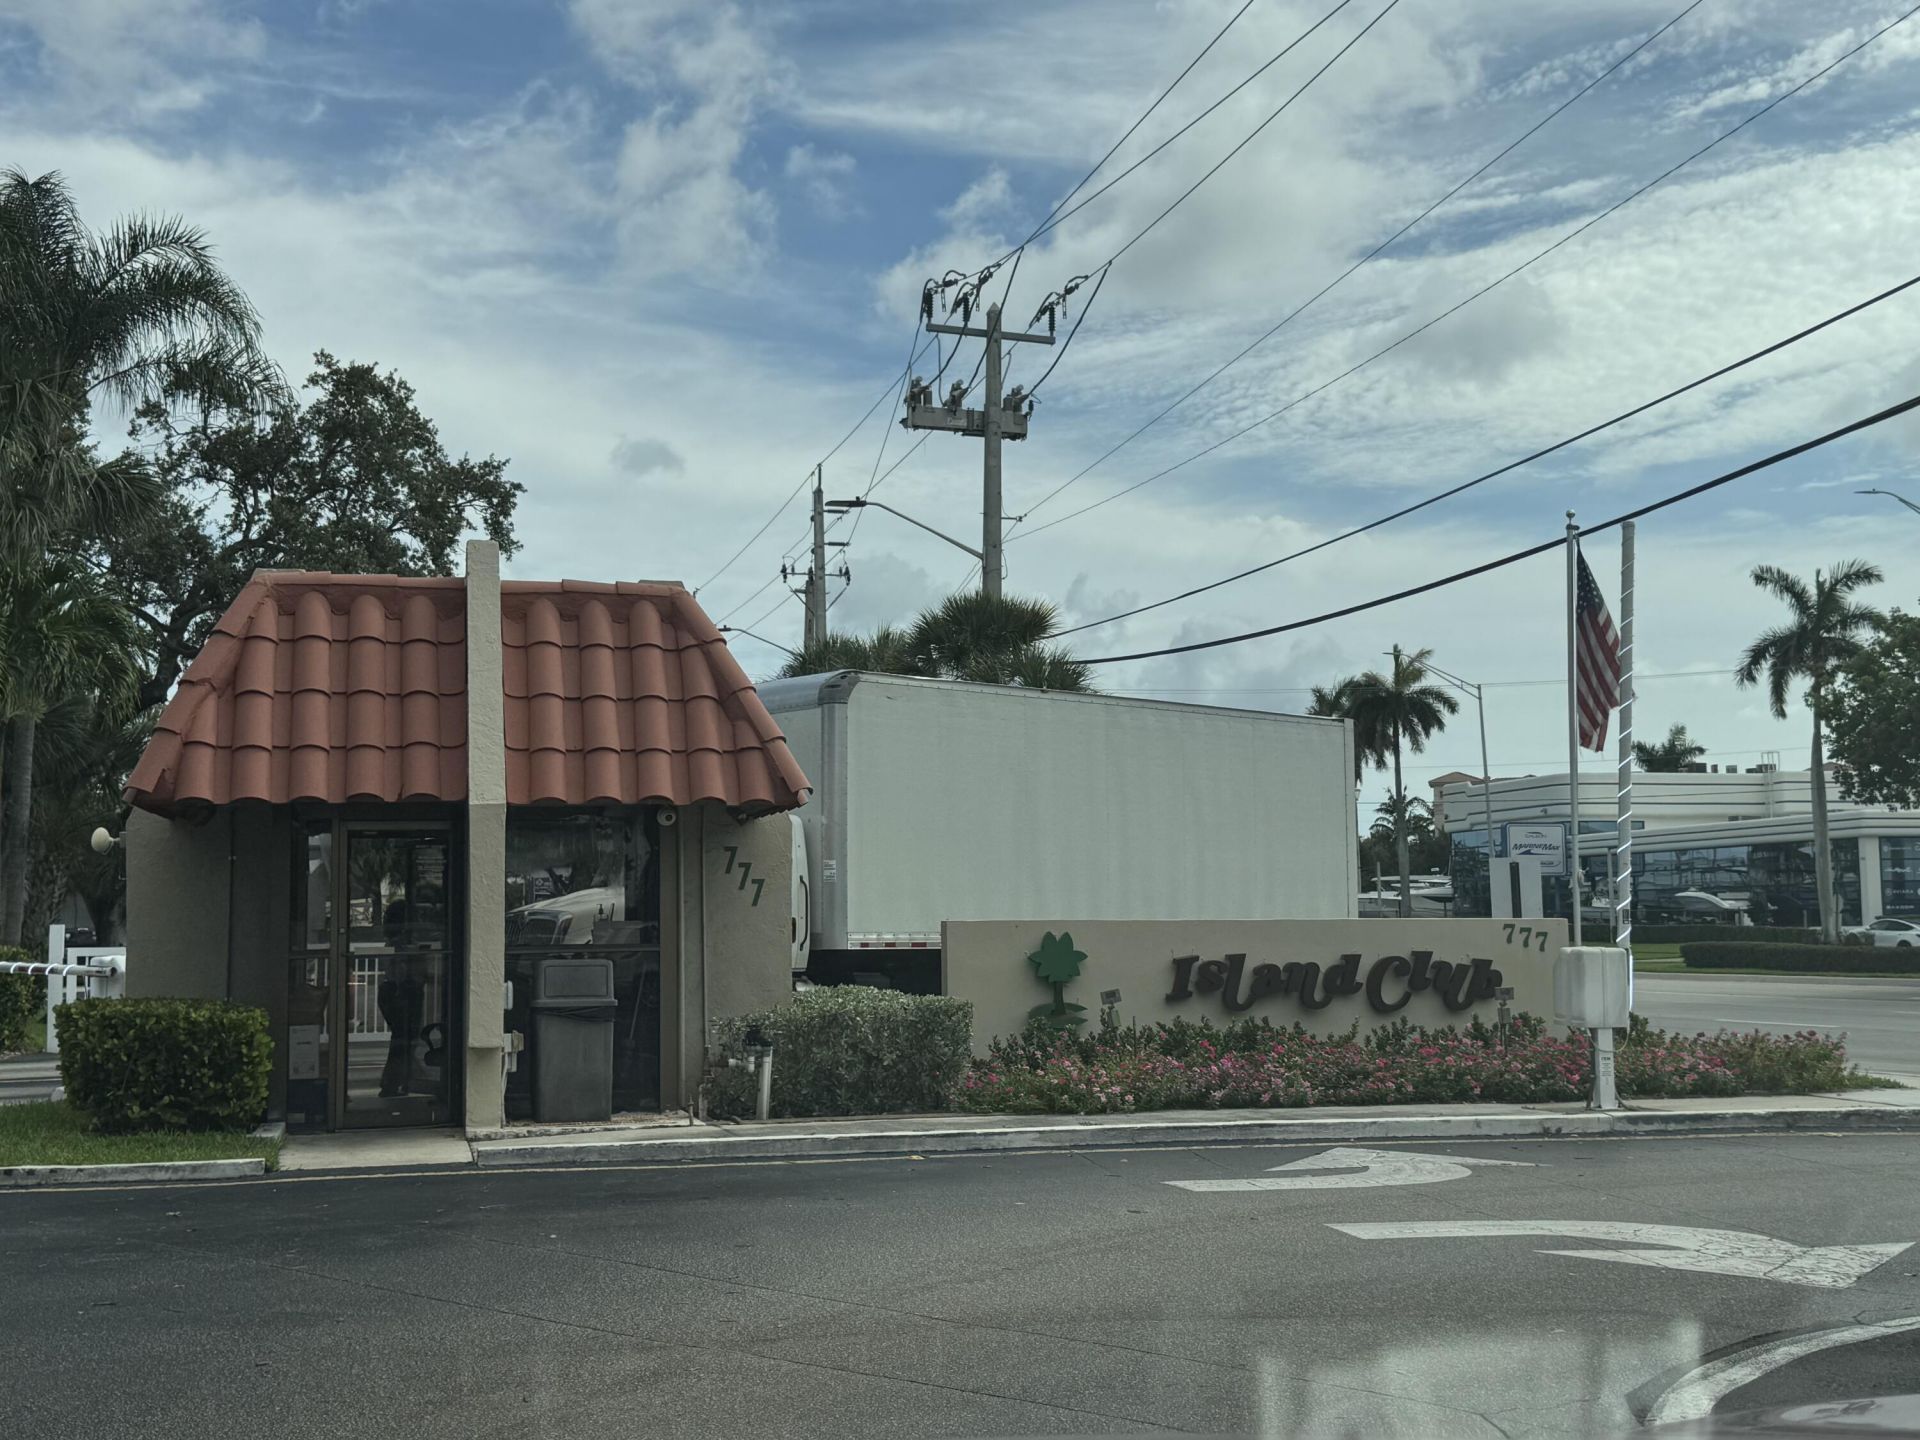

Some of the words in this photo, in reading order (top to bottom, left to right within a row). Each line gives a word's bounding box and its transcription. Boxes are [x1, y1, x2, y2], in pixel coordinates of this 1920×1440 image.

[724, 846, 765, 907] 777
[1503, 923, 1549, 952] 777
[1165, 953, 1364, 1012] Island
[1366, 950, 1503, 1013] Club
